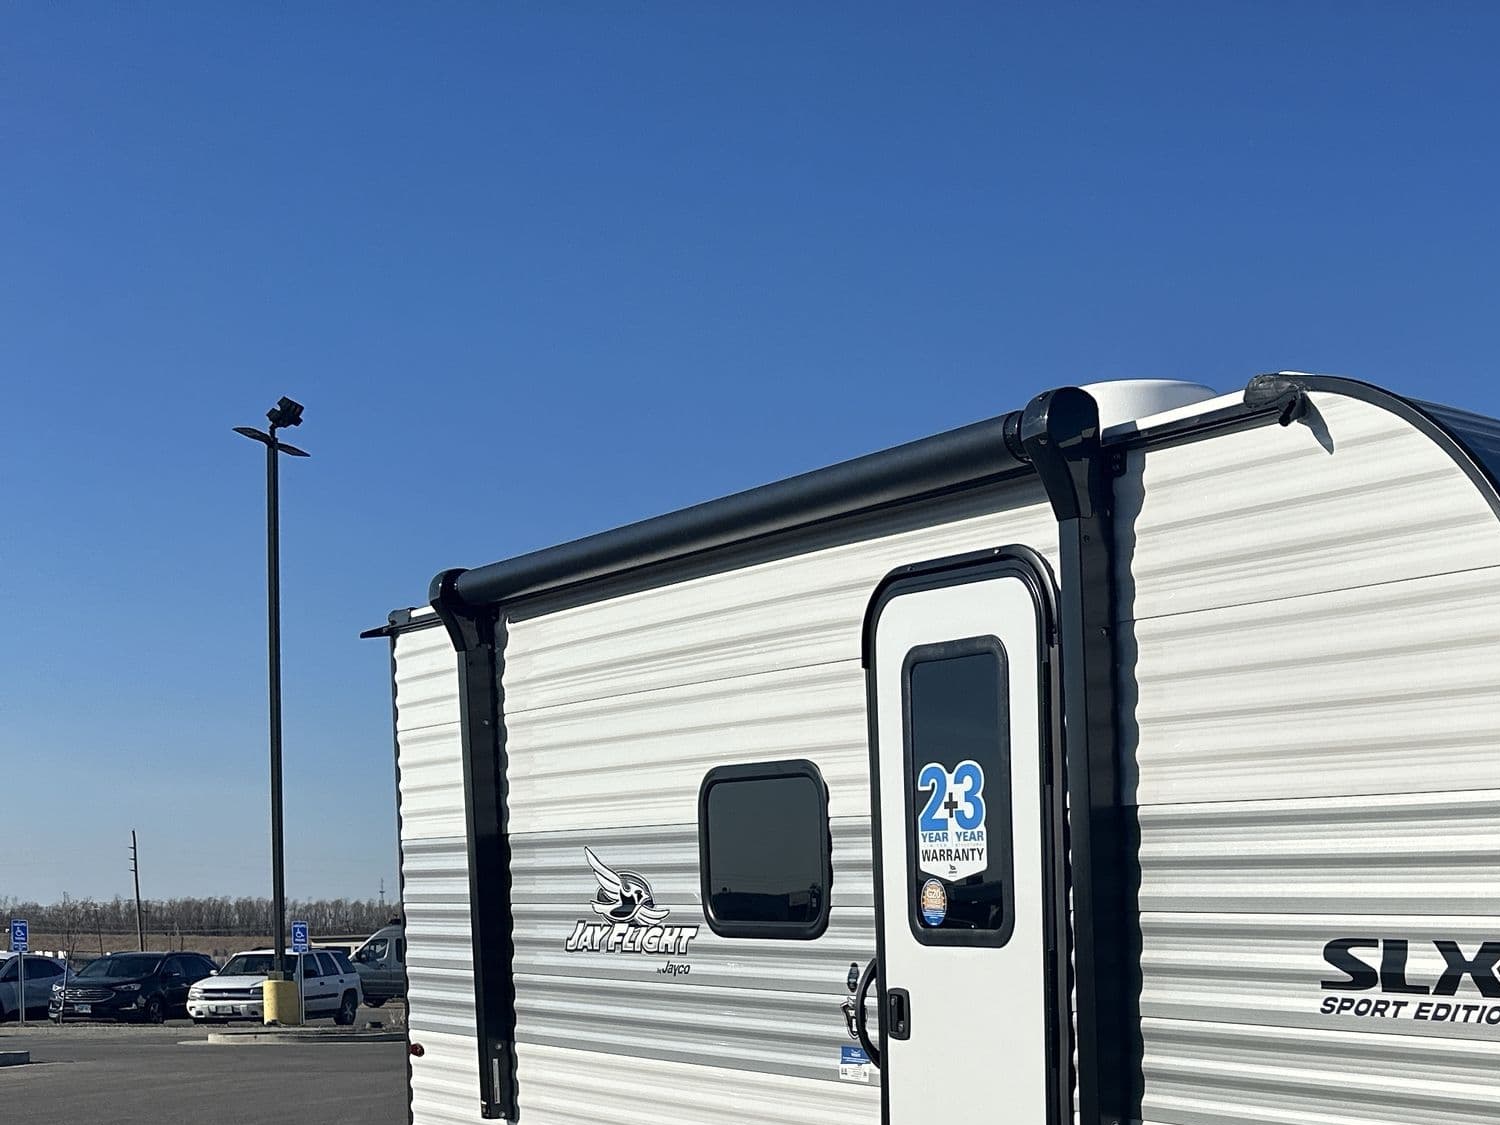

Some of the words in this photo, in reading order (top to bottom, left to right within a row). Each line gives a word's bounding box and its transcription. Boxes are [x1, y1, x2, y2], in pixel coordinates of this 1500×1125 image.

[921, 831, 949, 843] YEAR
[955, 830, 984, 842] YEAR
[921, 847, 985, 863] WARRANTY
[565, 921, 612, 952] JAY
[606, 921, 700, 955] FLIGHT
[661, 960, 691, 977] Jayco
[1320, 996, 1409, 1019] SPORT
